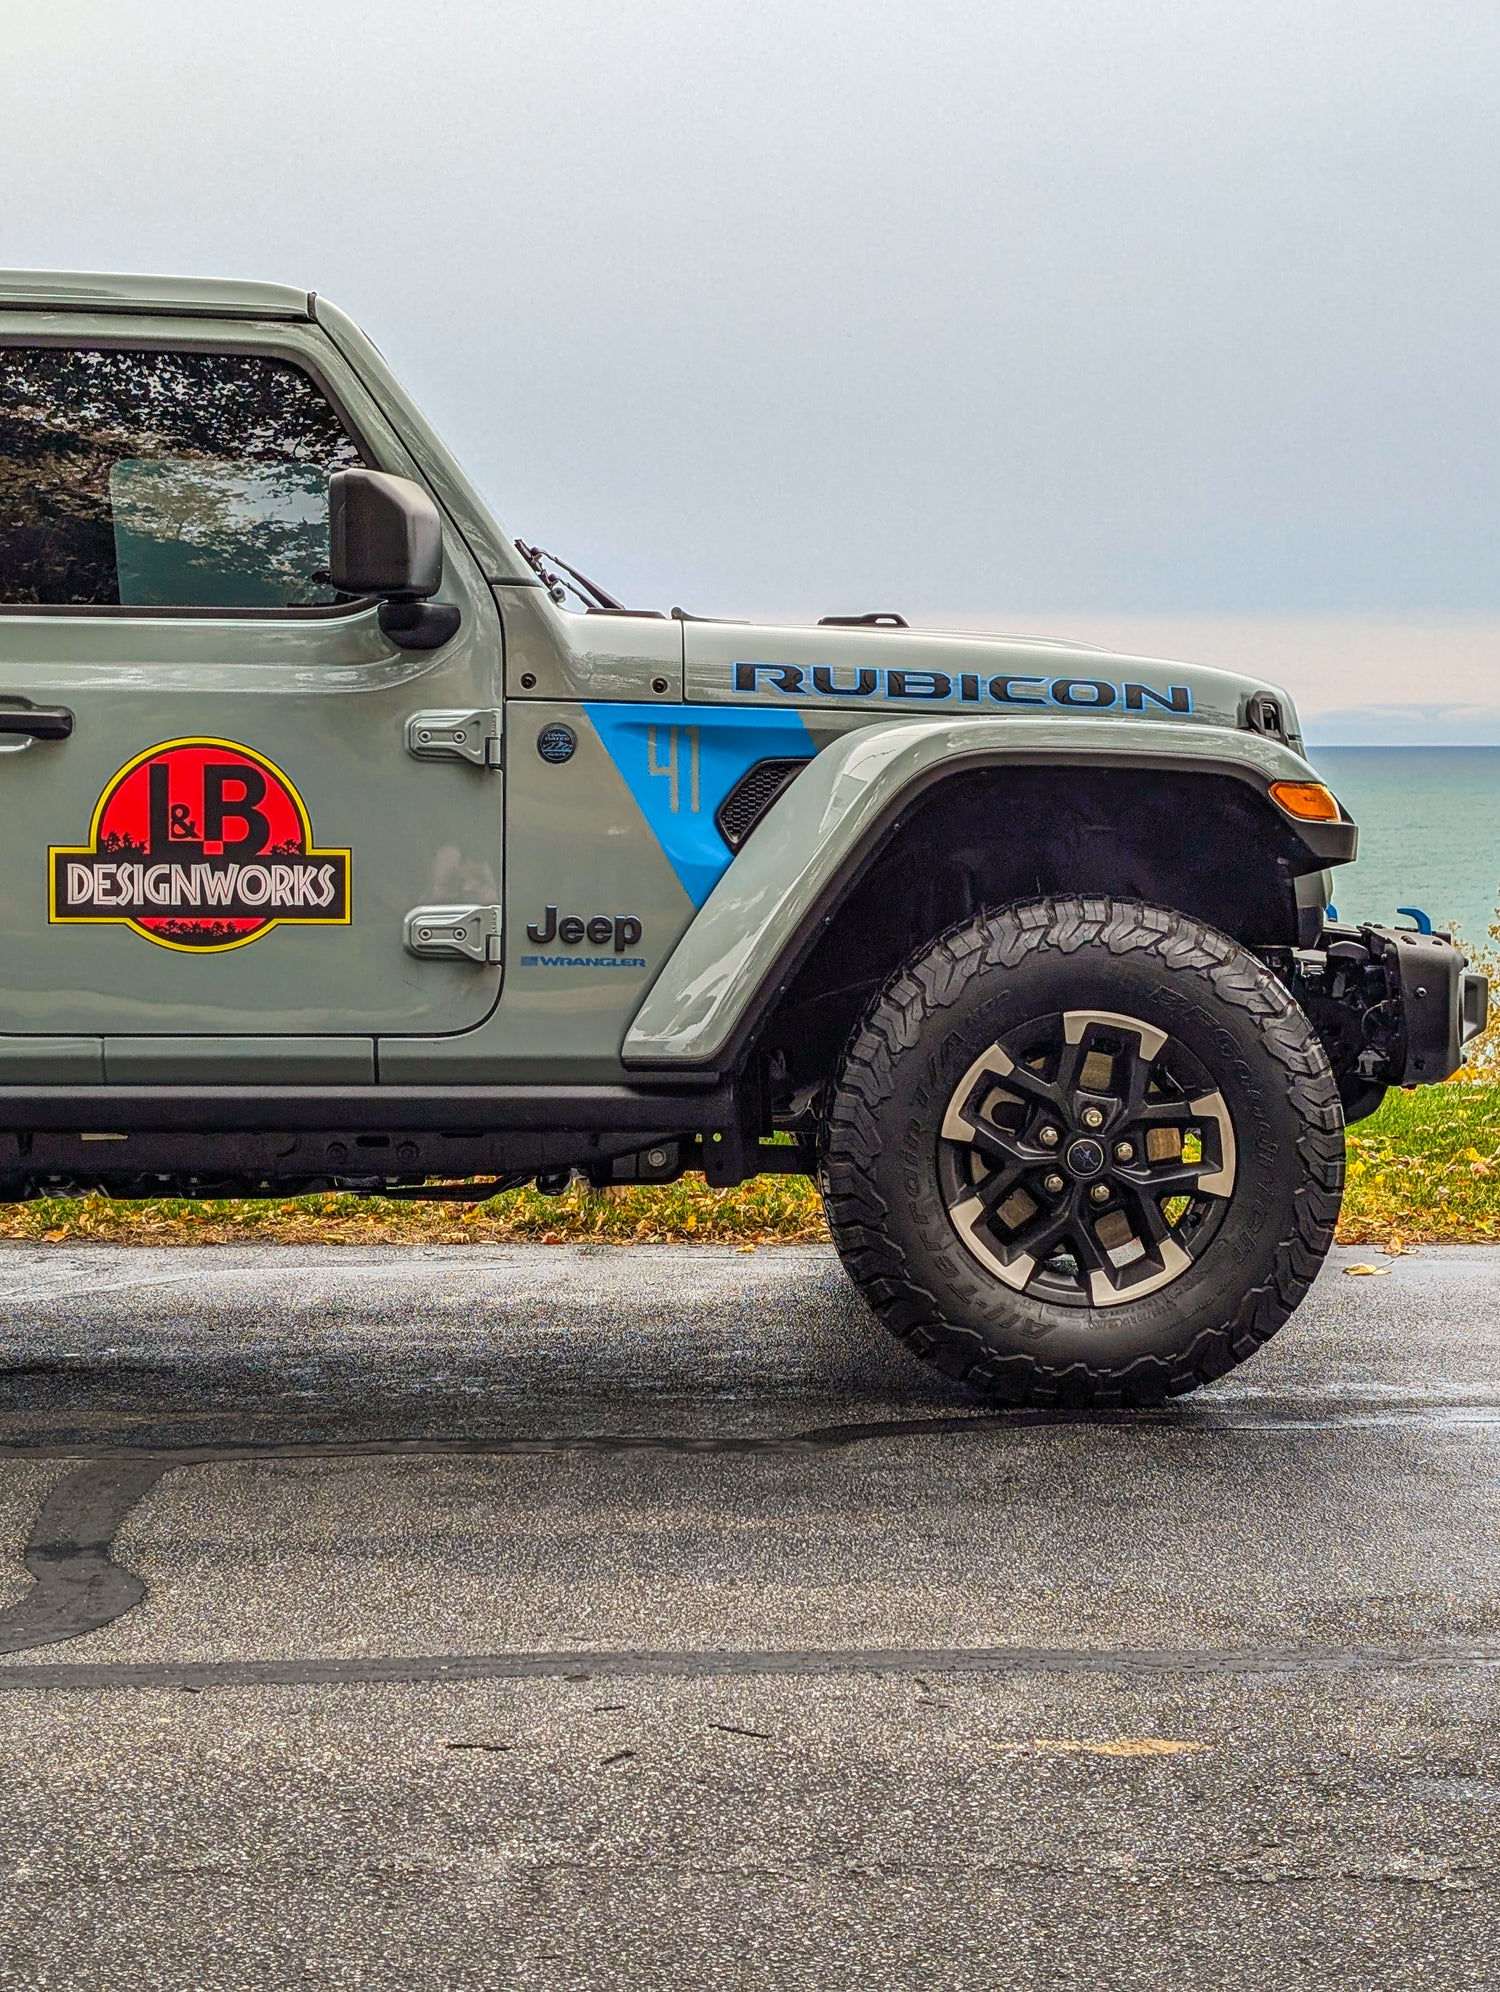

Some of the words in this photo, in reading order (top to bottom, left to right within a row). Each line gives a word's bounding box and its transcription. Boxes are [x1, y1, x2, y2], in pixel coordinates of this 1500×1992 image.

[731, 661, 1194, 715] RUBICON
[647, 724, 700, 814] 41
[149, 763, 271, 855] L&B
[66, 862, 336, 907] DESIGNWORKS
[526, 904, 642, 951] Jeep
[540, 955, 646, 967] WRANGLER
